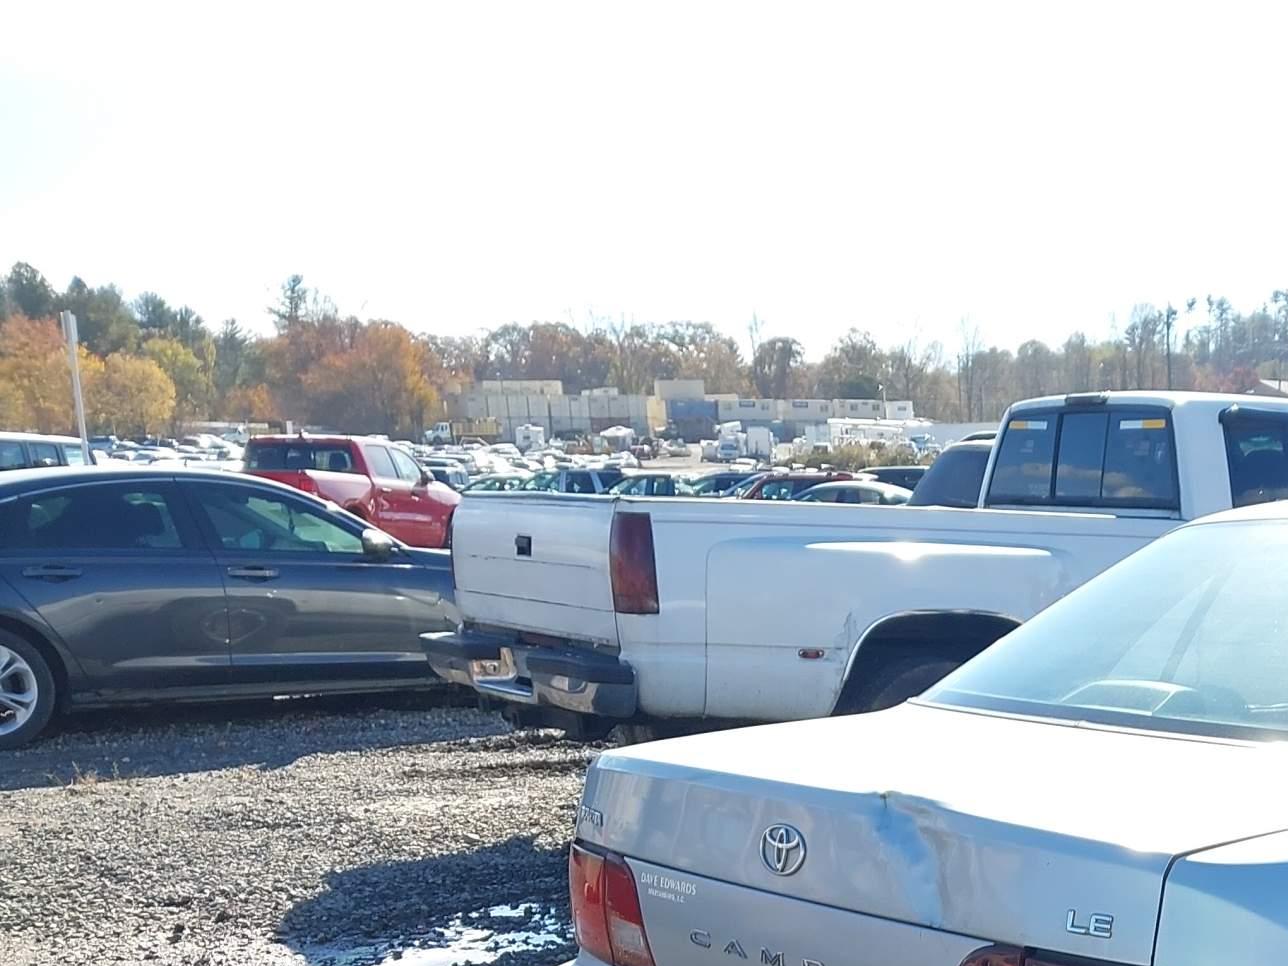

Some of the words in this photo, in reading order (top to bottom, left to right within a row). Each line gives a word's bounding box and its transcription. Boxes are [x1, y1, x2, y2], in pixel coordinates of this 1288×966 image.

[641, 872, 658, 887] DAVE
[660, 876, 697, 895] EDWARDS
[1066, 909, 1114, 939] LE
